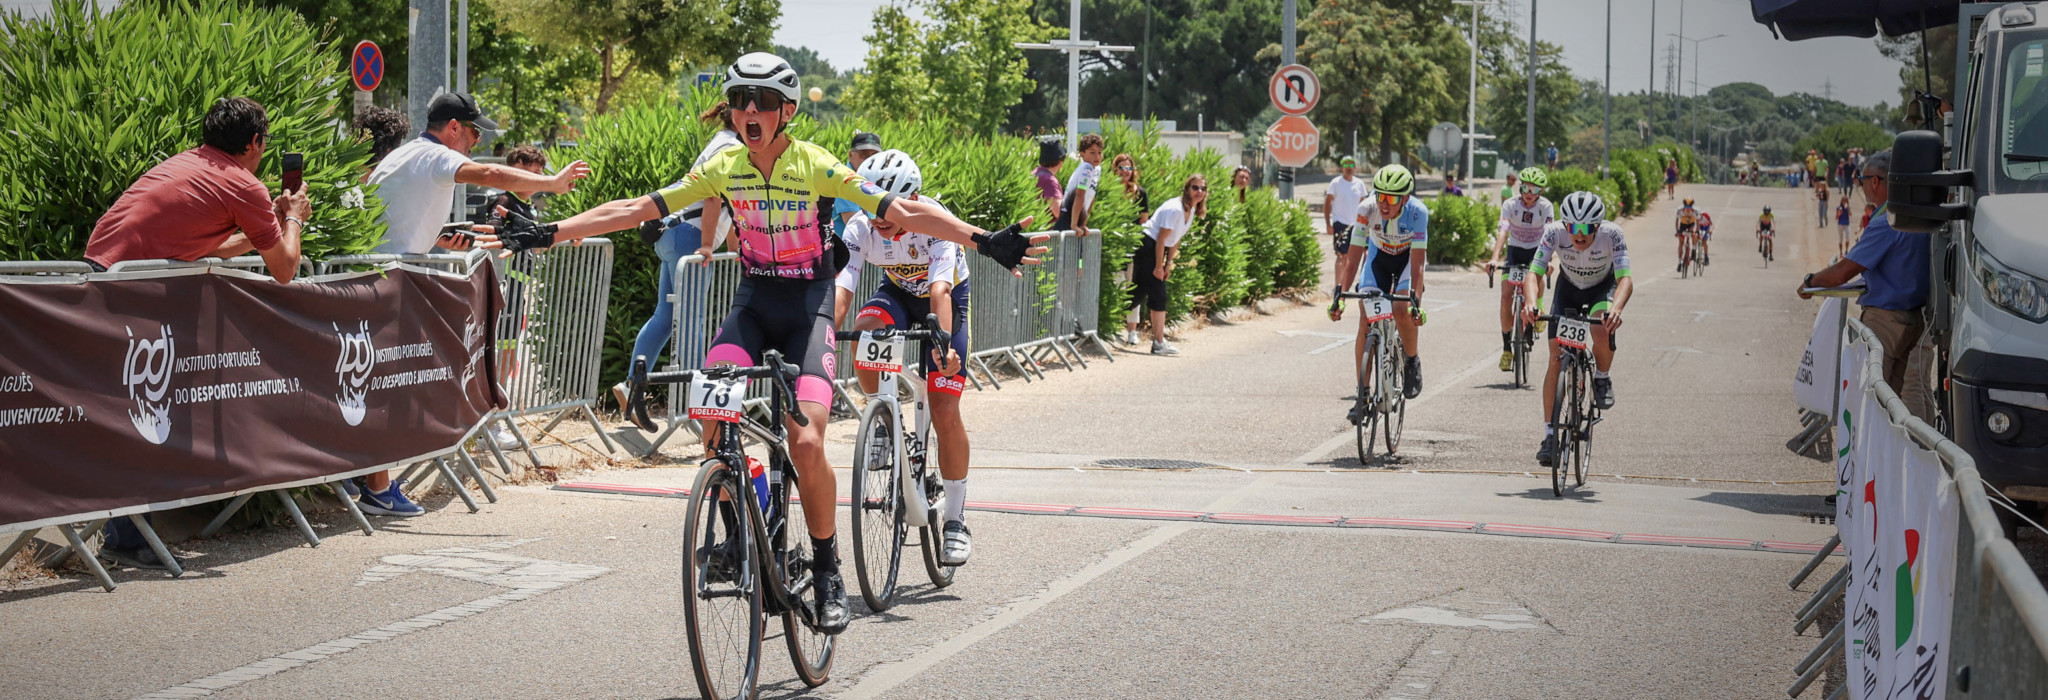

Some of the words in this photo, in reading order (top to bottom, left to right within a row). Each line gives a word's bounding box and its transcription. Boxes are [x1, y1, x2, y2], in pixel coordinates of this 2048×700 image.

[1271, 131, 1316, 151] STOP
[731, 199, 808, 211] MATDIVER
[1511, 272, 1523, 282] 95
[1374, 302, 1381, 315] 5
[1559, 324, 1586, 342] 238
[175, 353, 217, 373] INSTITUTO
[217, 347, 261, 368] PORTUGUÊS
[375, 345, 402, 364] INSTITUTO
[401, 340, 433, 359] PORTUGUÊS
[867, 342, 893, 363] 94
[122, 324, 175, 402] ipdj
[371, 376, 382, 391] DO
[381, 370, 414, 390] DESPORTO
[413, 371, 417, 385] E
[946, 380, 963, 389] SGR
[175, 388, 188, 405] DO
[190, 383, 237, 404] DESPORTO
[237, 384, 243, 398] E
[243, 379, 290, 398] JUVENTUDE,
[702, 382, 731, 408] 76
[691, 408, 737, 419] FIDELIDADE
